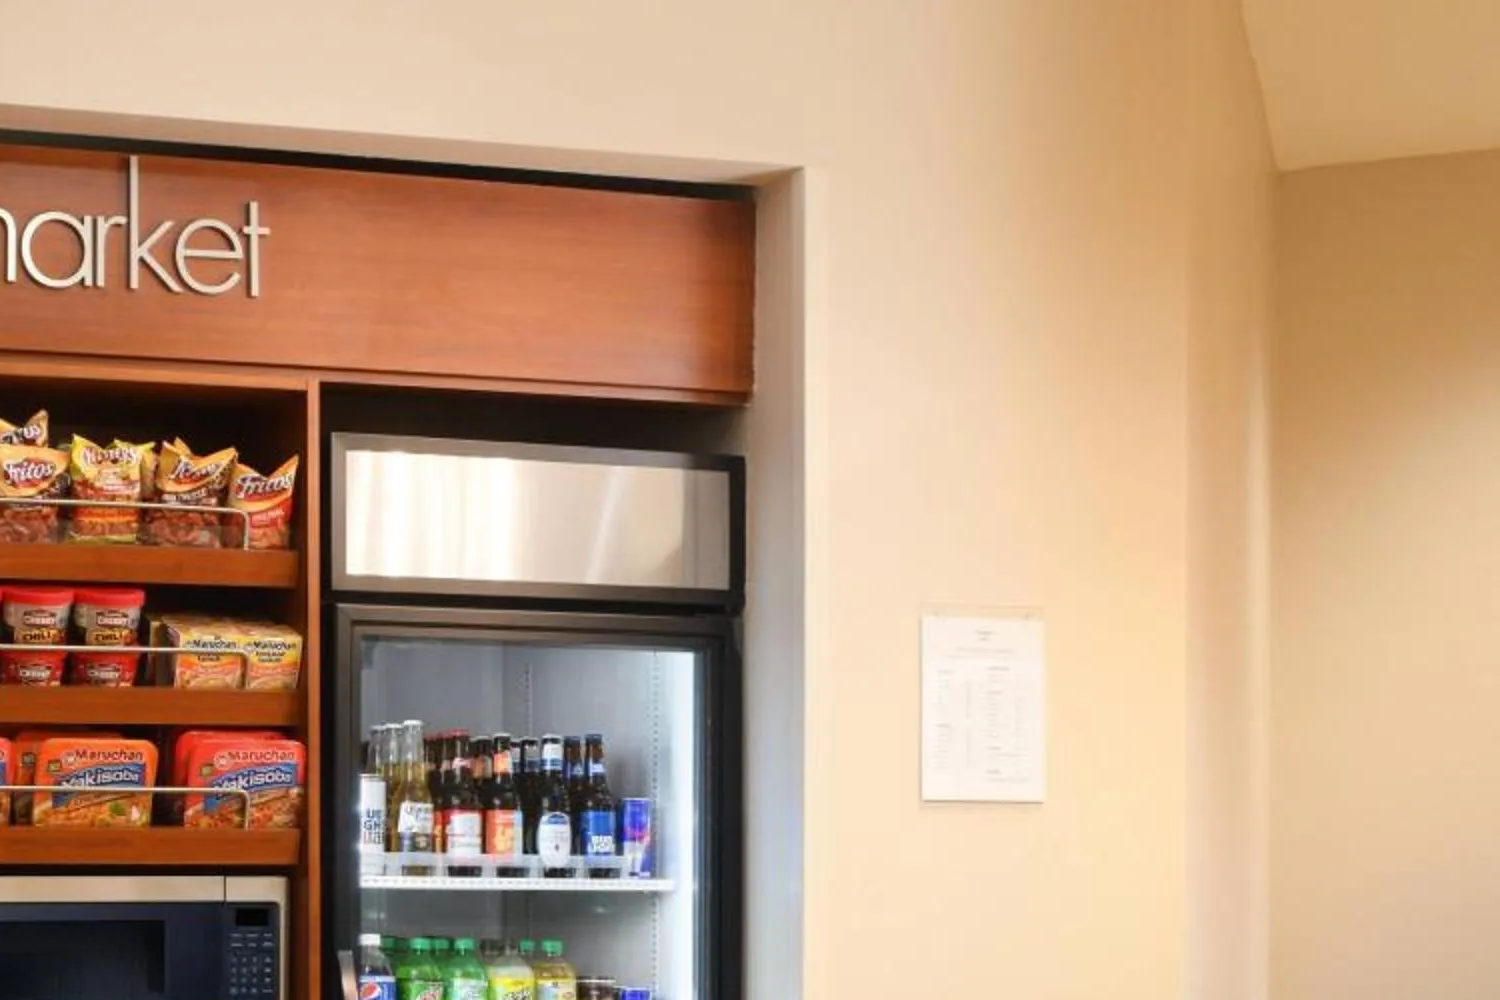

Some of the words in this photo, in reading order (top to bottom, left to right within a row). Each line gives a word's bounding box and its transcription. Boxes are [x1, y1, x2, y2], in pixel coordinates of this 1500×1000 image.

[4, 461, 54, 483] Fritos
[236, 474, 294, 500] Fritos
[76, 750, 143, 762] Maruchan
[229, 750, 296, 762] Maruchan
